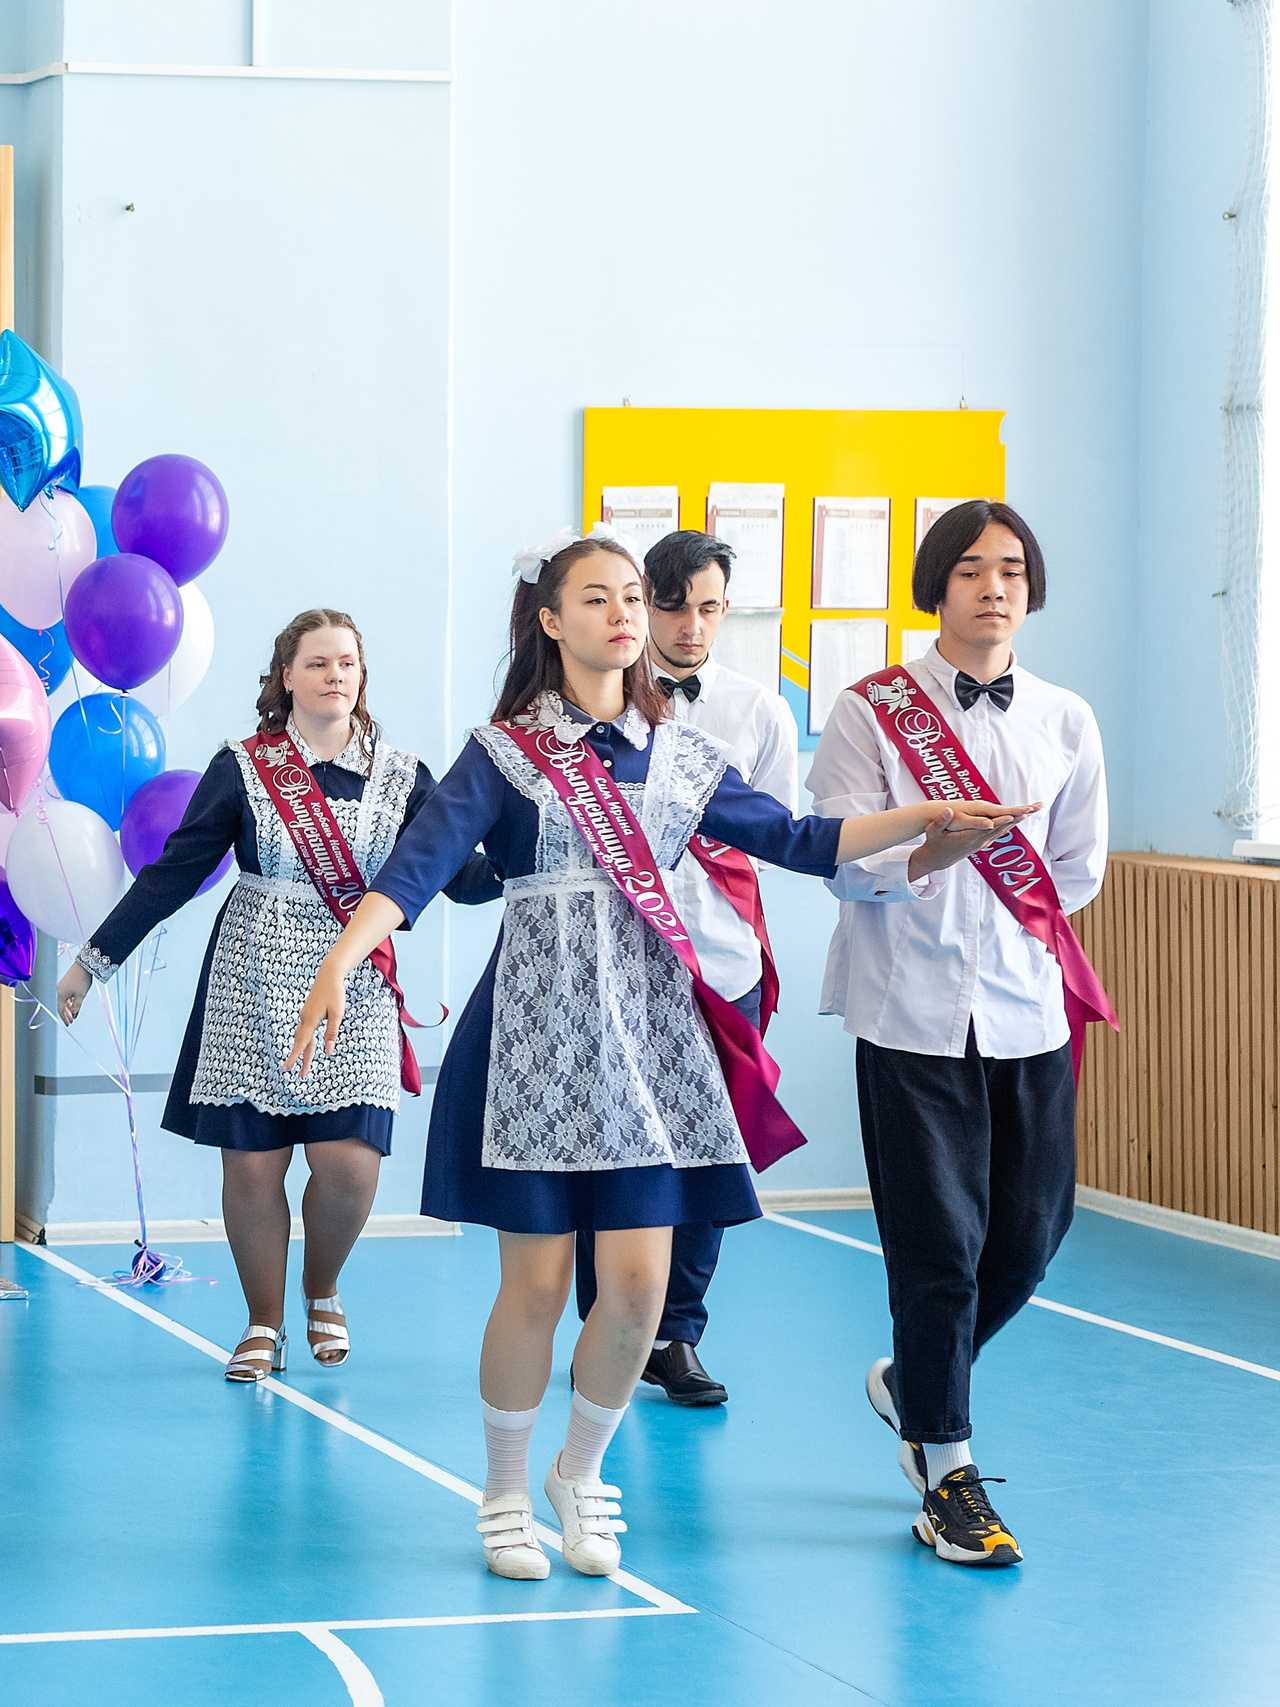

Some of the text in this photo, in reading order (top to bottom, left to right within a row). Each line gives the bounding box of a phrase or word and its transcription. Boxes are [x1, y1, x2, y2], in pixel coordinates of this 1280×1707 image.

[895, 706, 965, 801] Выпуск
[941, 747, 982, 801] Ким Влади
[594, 777, 634, 836] Сим Ирина
[926, 786, 942, 801] МБО
[273, 764, 364, 918] Выпускница 20
[292, 828, 305, 844] МБОУ
[300, 845, 310, 858] СОШ
[310, 801, 352, 878] Корбань Наталья
[536, 731, 689, 942] Выпускница 2021
[570, 806, 588, 826] МБОУ
[582, 826, 596, 842] СОШ
